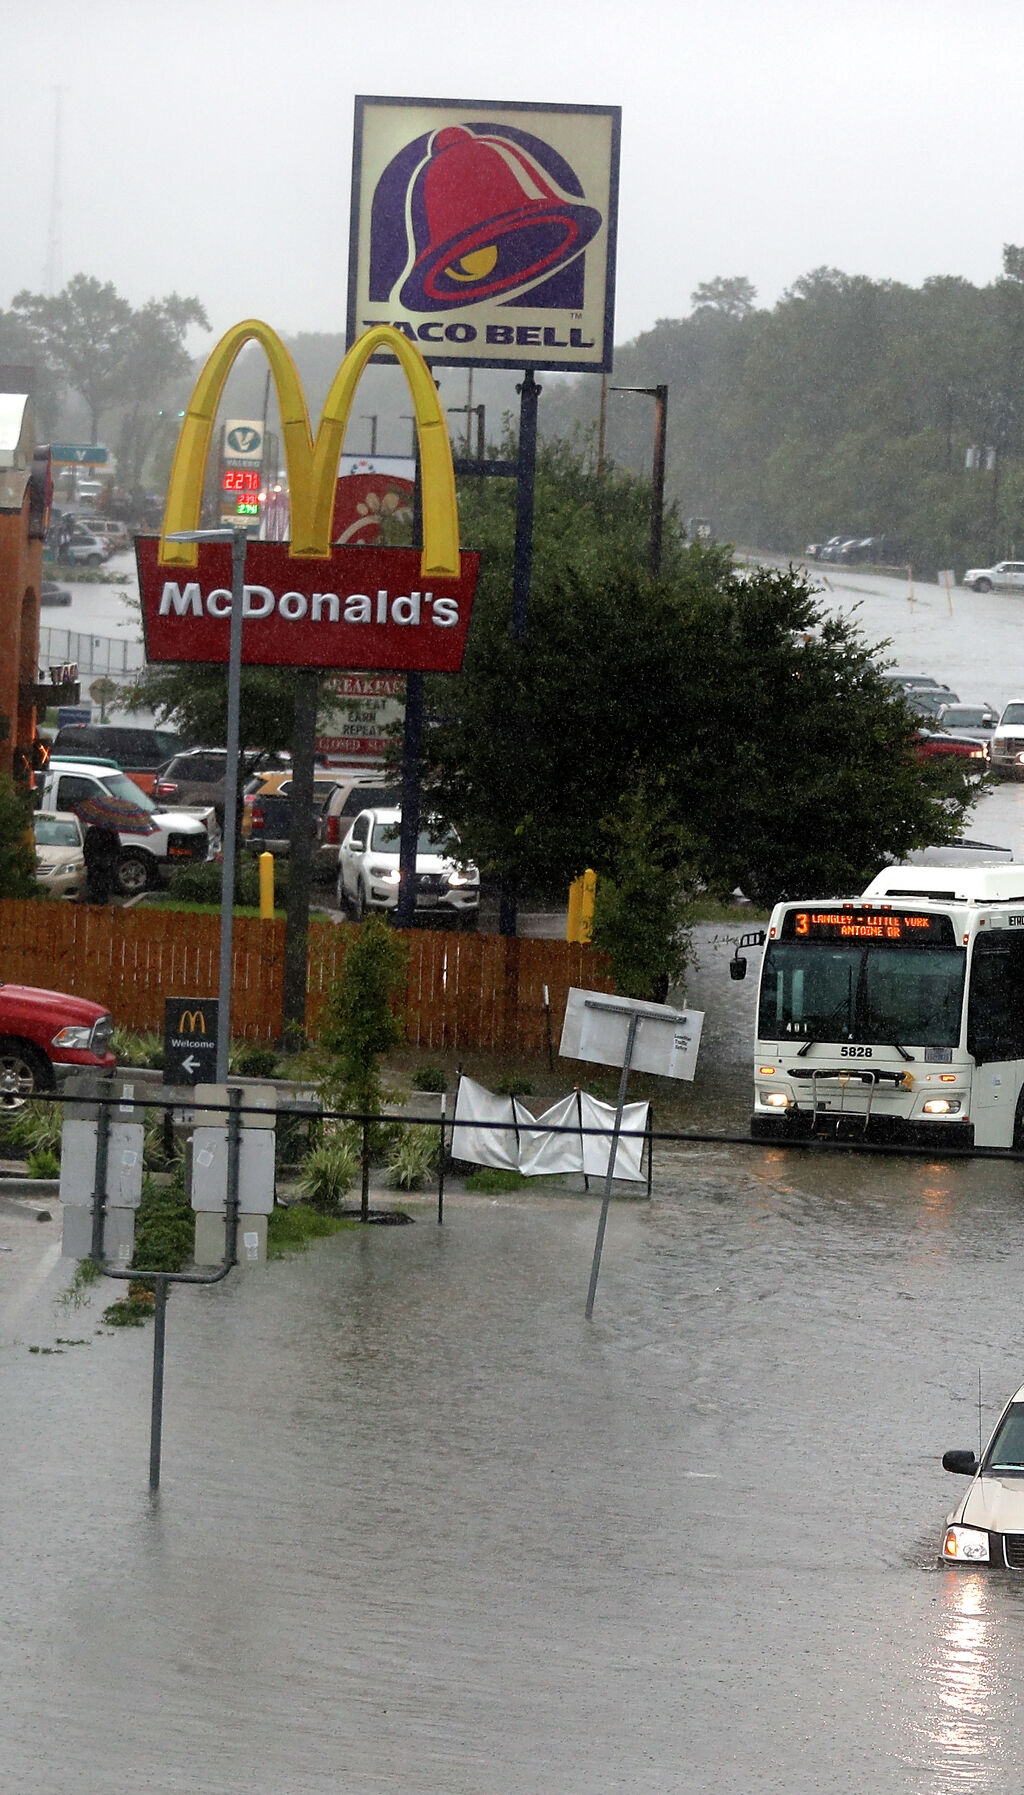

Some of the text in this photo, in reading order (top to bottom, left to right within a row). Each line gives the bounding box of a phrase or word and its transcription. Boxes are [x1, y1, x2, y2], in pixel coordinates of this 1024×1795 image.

[486, 324, 595, 348] BELL
[158, 582, 460, 628] McDonald's
[796, 913, 809, 934] 3
[812, 914, 853, 925] LANGLEY
[867, 916, 899, 926] LITTLE
[841, 925, 883, 936] ANTOINE
[171, 1039, 215, 1049] Welcome
[840, 1046, 873, 1058] 5828
